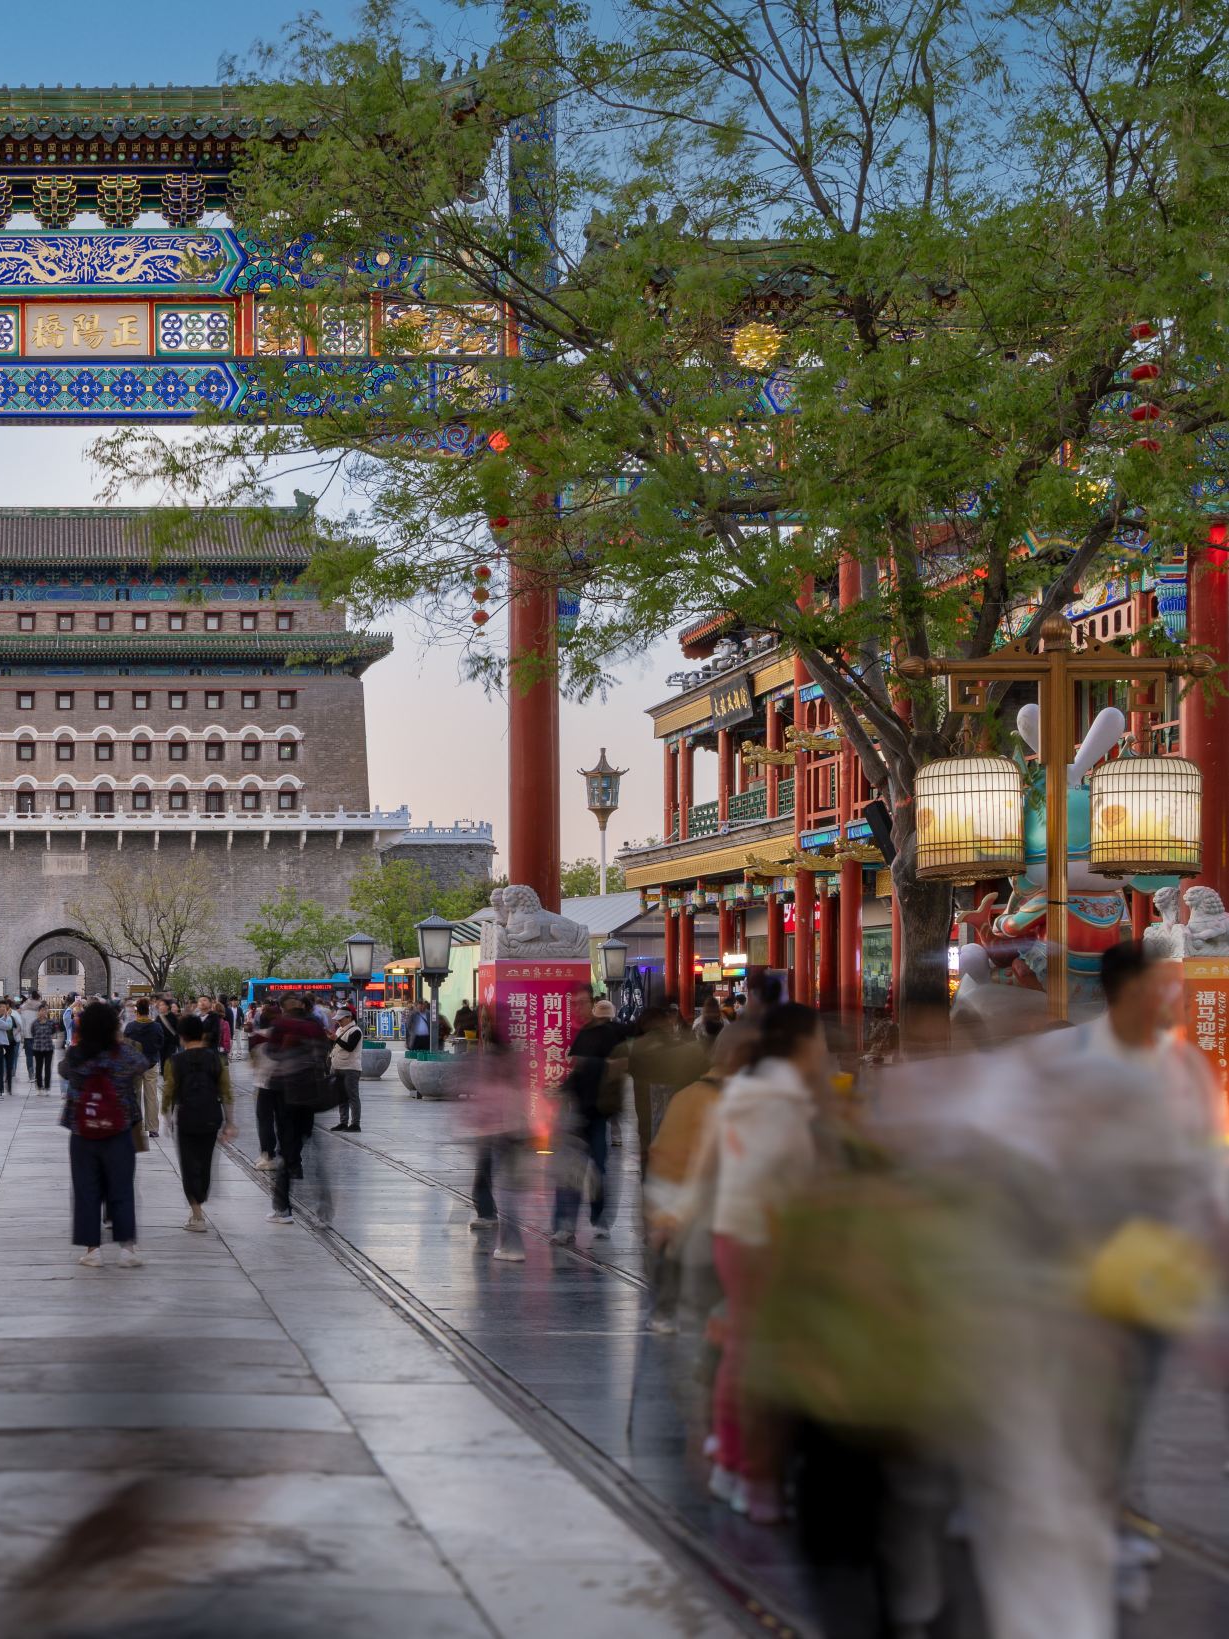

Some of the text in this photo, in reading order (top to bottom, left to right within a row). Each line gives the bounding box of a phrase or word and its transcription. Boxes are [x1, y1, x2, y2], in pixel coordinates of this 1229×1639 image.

[31, 313, 141, 349] 正陽橋
[529, 993, 538, 1016] 2026
[1196, 990, 1216, 1051] 福马迎春
[508, 993, 529, 1053] 福马迎春
[530, 1018, 538, 1036] The
[1218, 991, 1227, 1056] 2026 The Year
[530, 1038, 538, 1057] Year
